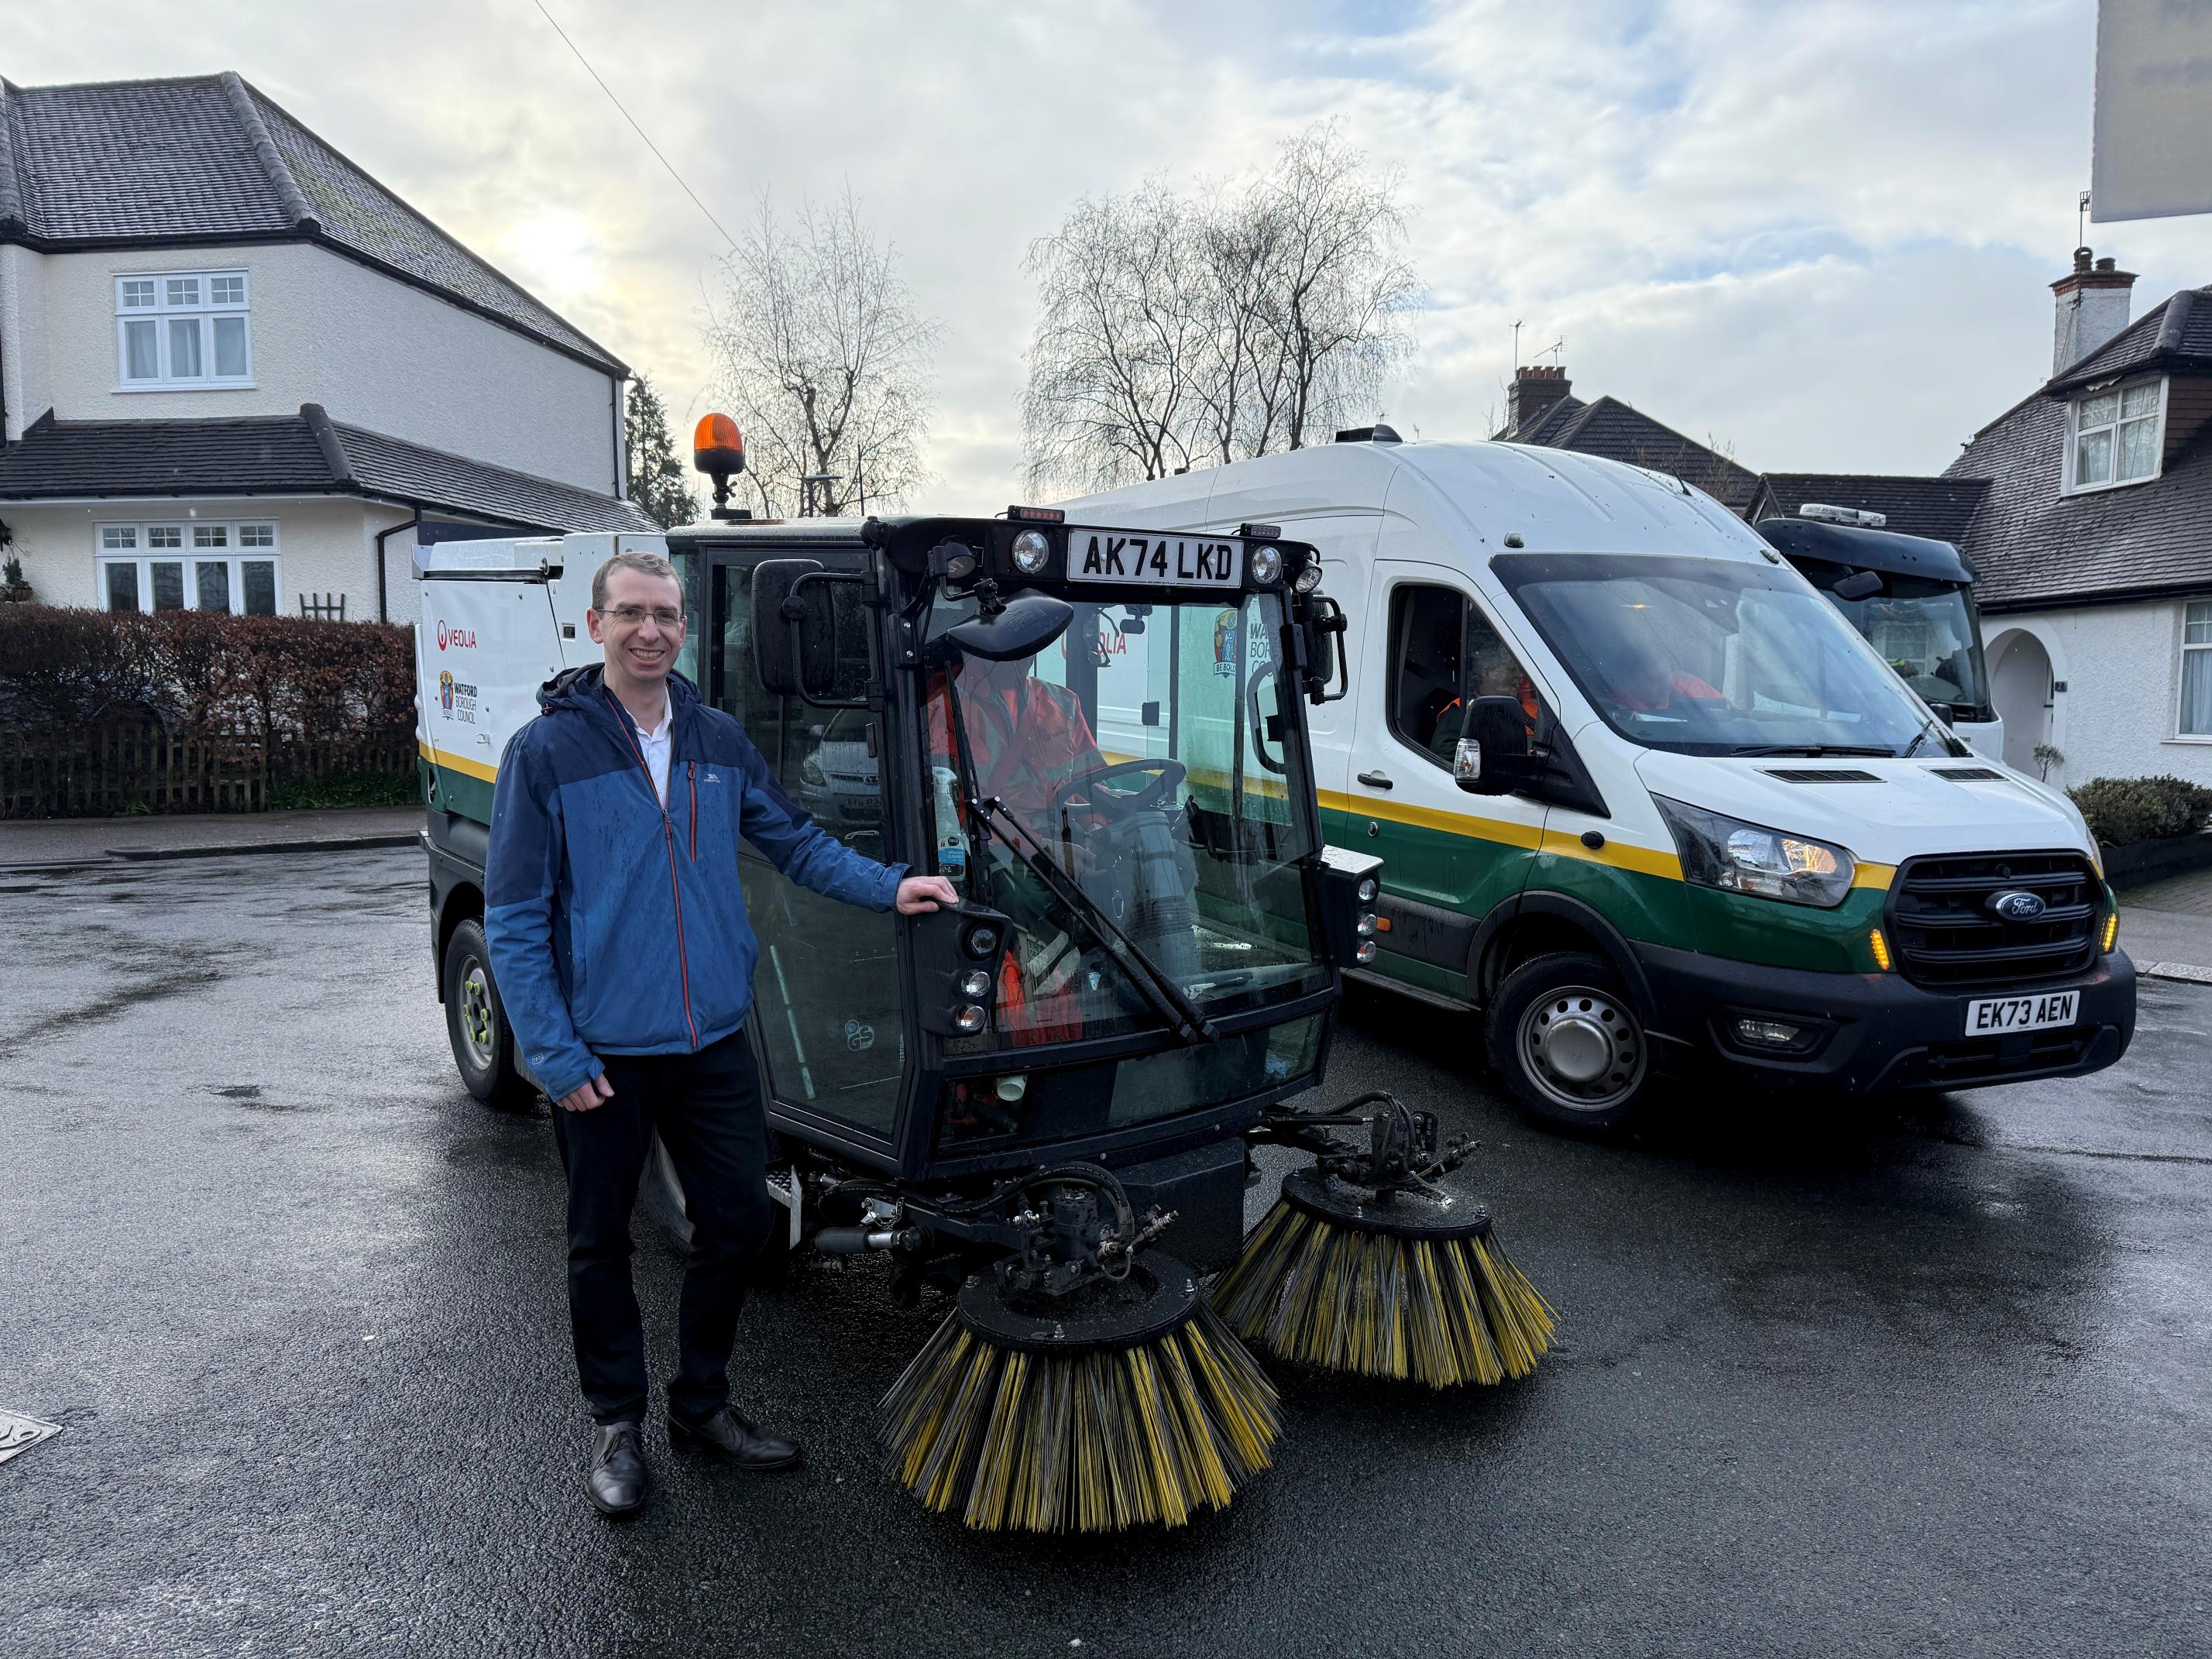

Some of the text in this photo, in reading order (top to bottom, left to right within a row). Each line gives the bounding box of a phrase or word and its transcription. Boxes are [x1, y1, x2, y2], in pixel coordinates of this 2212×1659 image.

[1083, 536, 1232, 580] AK74 LKD
[448, 628, 476, 648] VEOLIA
[454, 682, 477, 697] WATFORD
[455, 696, 476, 711] BOROUGH
[457, 709, 476, 724] COUNCIL
[2012, 898, 2039, 915] Ford
[1977, 994, 2073, 1029] EK73 AEN
